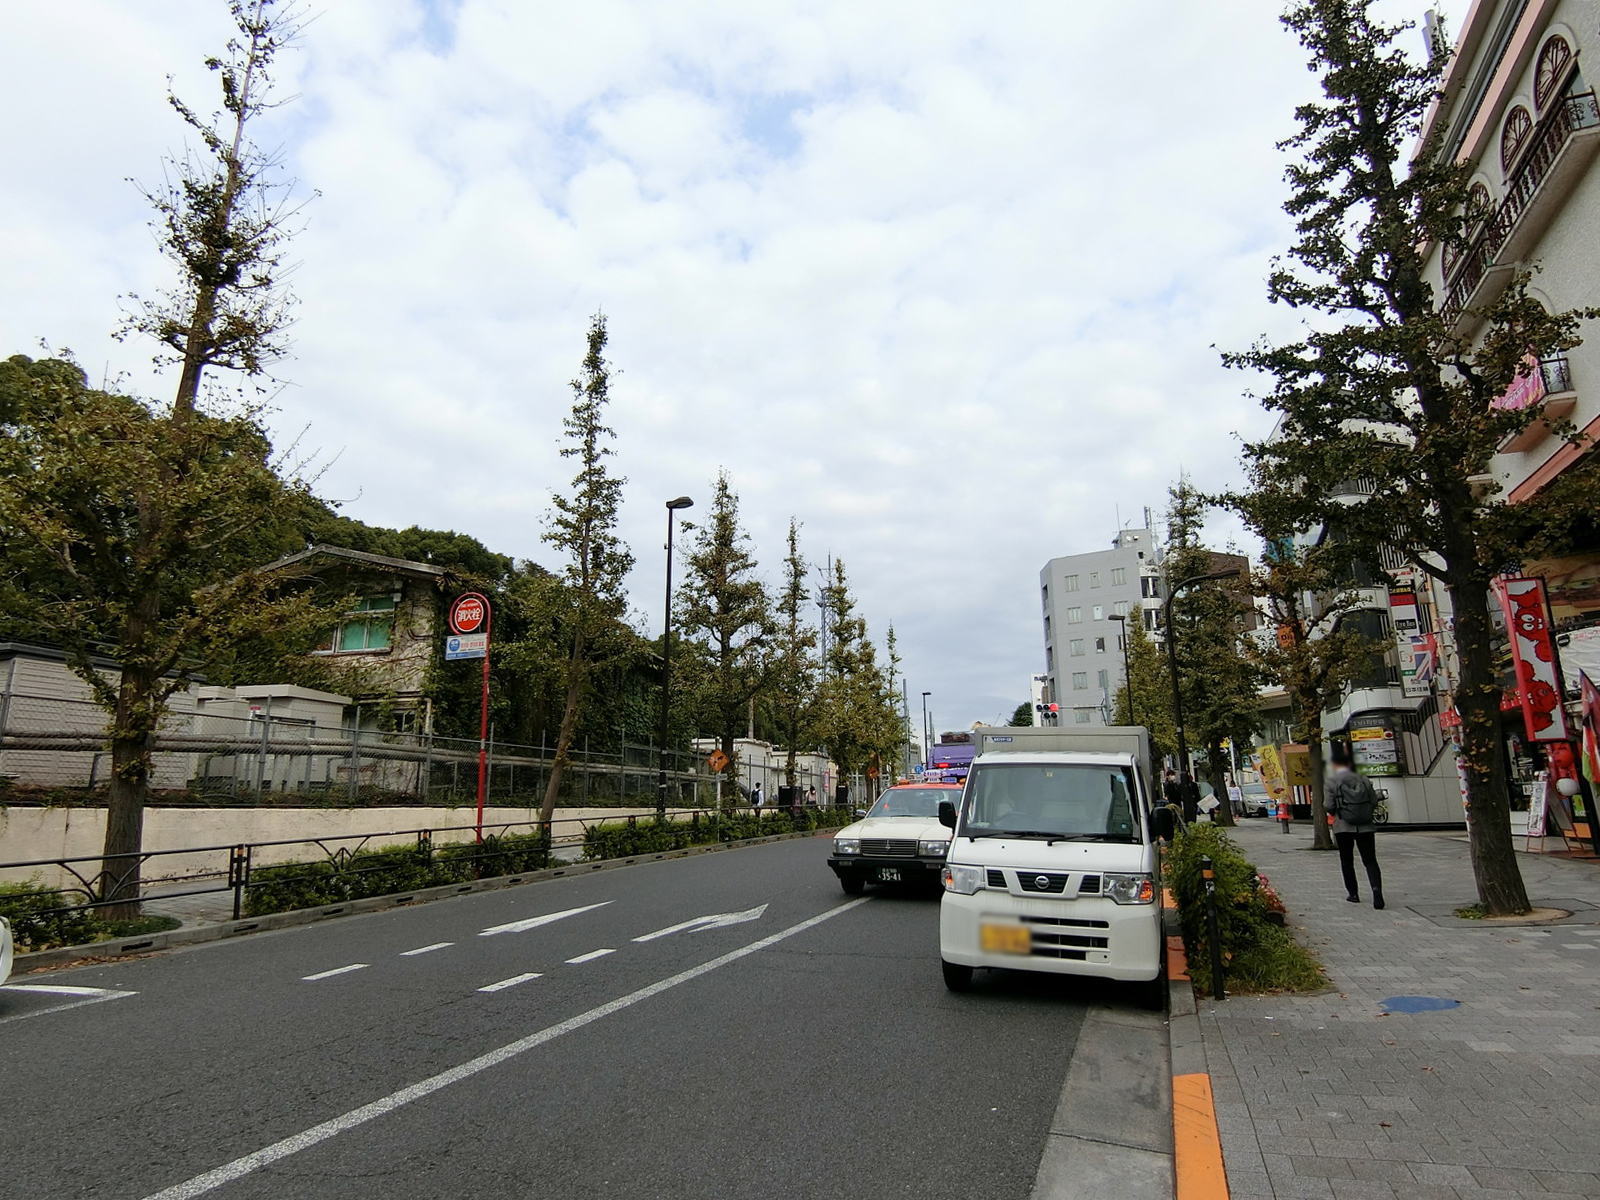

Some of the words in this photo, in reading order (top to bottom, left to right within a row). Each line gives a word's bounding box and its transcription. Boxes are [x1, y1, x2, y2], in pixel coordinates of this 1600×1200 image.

[457, 607, 481, 622] 消火栓
[881, 872, 902, 881] 35-41
